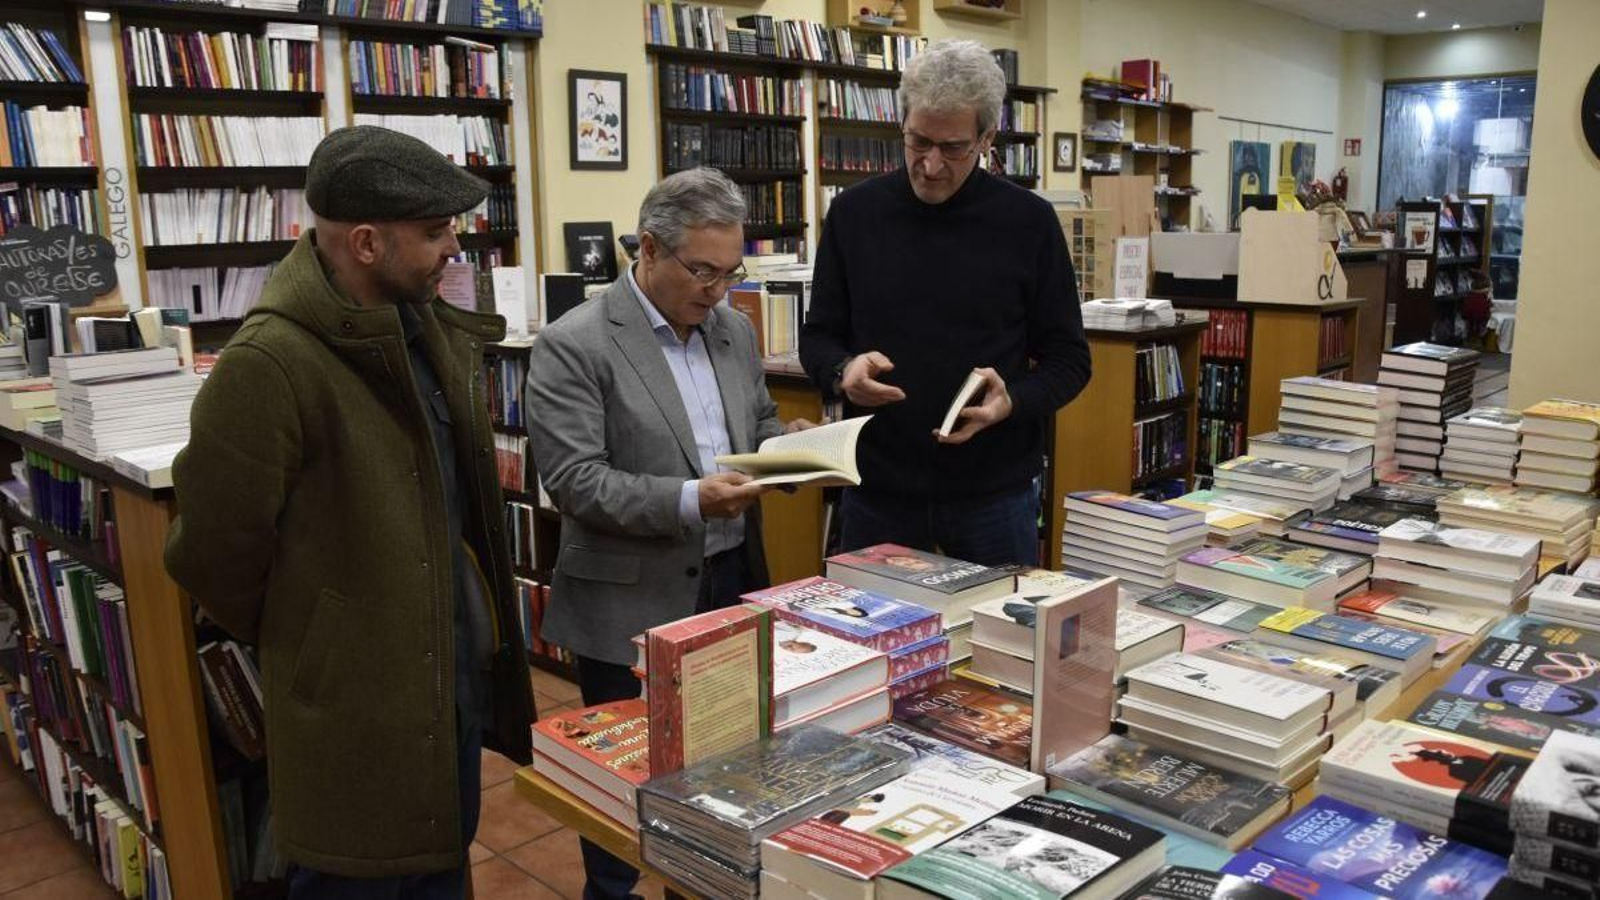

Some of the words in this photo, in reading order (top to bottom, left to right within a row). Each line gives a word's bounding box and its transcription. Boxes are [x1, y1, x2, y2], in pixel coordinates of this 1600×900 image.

[105, 167, 131, 259] GALEGO
[1144, 761, 1206, 799] MUERTE
[1056, 811, 1076, 821] EN
[1074, 816, 1090, 827] LA
[1091, 822, 1133, 841] ARENA
[1284, 808, 1340, 843] REBECCA
[1301, 815, 1352, 846] YARROS
[1322, 841, 1355, 871] LAS
[1349, 816, 1397, 853] COSAS
[1373, 834, 1450, 892] PRECIOSAS
